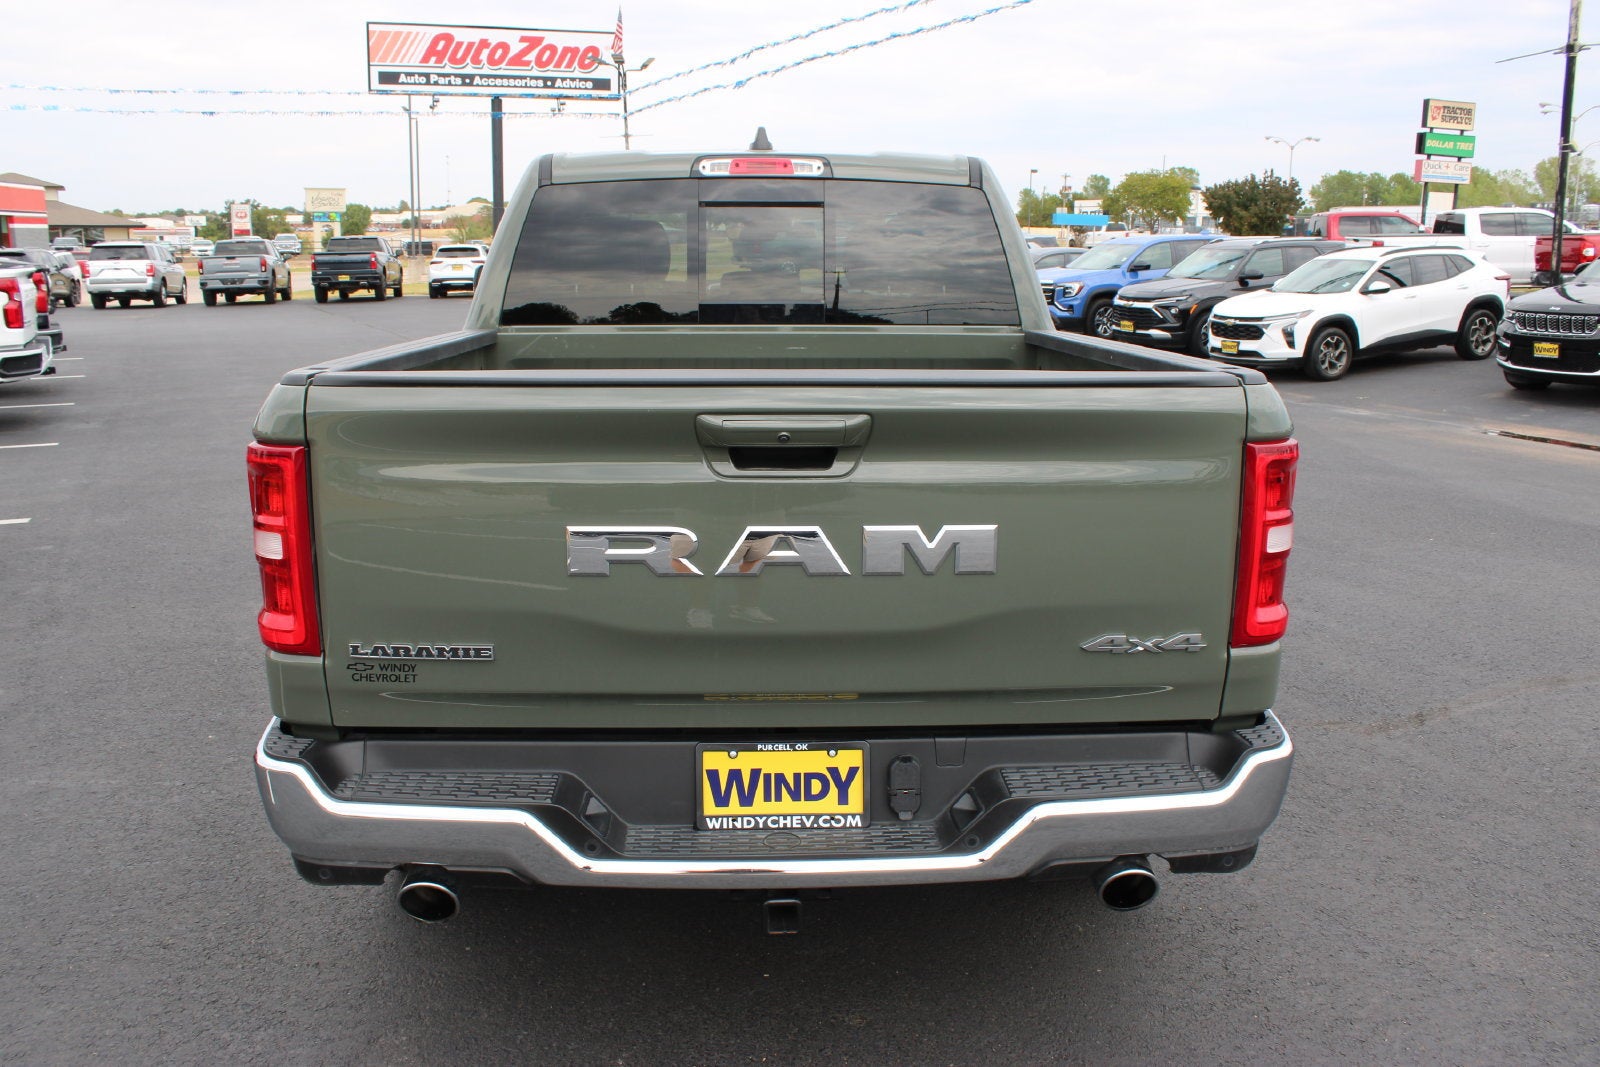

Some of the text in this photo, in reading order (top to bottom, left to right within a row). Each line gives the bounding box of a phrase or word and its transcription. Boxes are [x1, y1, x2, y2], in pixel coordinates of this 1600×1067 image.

[419, 32, 602, 71] AutoZone
[398, 73, 593, 89] Auto Parts Accessories Advice
[1442, 105, 1472, 116] TRACTOR
[1441, 115, 1464, 125] SUPPLY
[1426, 139, 1474, 150] DOLLAR TREE
[1424, 161, 1469, 172] Quick Care
[1534, 345, 1558, 354] WINDY
[566, 525, 999, 577] RAM
[1079, 632, 1207, 654] 4x4
[349, 643, 494, 660] LARAMIE
[378, 663, 417, 673] WINDY
[351, 672, 418, 683] CHEVROLET
[757, 743, 808, 752] PURCELL, OK
[705, 766, 860, 808] WINDY
[705, 815, 862, 830] WINDYCHEV.COM
